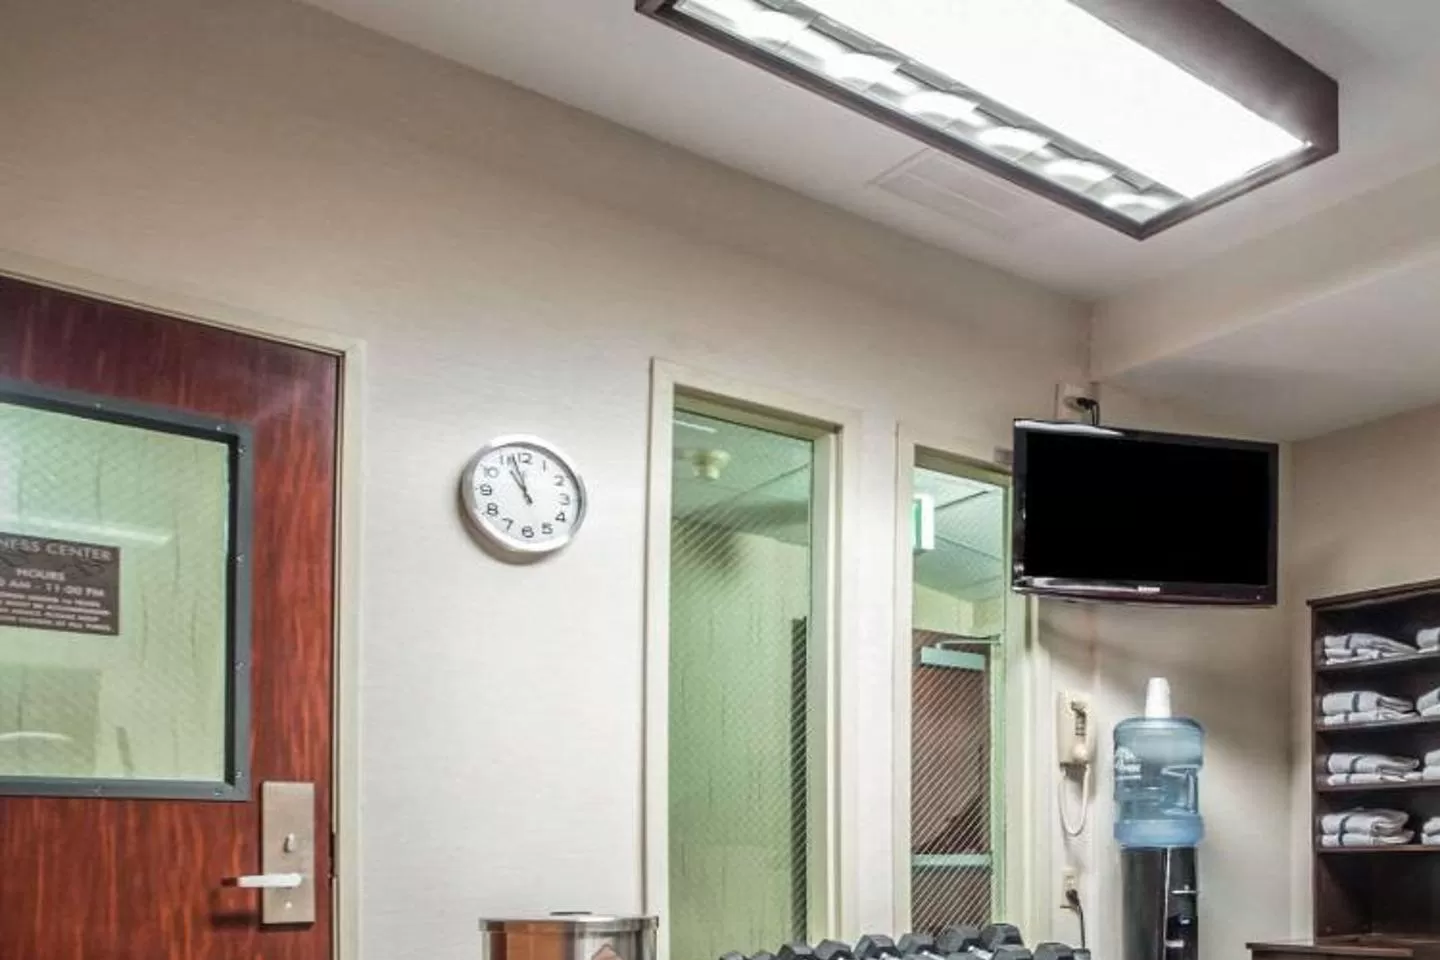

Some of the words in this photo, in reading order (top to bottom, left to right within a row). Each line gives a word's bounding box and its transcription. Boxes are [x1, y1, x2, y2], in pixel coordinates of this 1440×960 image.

[518, 452, 533, 465] 12
[554, 475, 566, 487] 2
[480, 484, 493, 496] 9
[559, 493, 571, 506] 3
[487, 503, 499, 516] 8
[555, 512, 567, 523] 4
[502, 518, 514, 531] 7
[541, 522, 553, 535] 5
[521, 525, 535, 538] 6
[46, 542, 112, 561] CENTER
[16, 568, 66, 582] HOURS
[85, 587, 105, 598] PM
